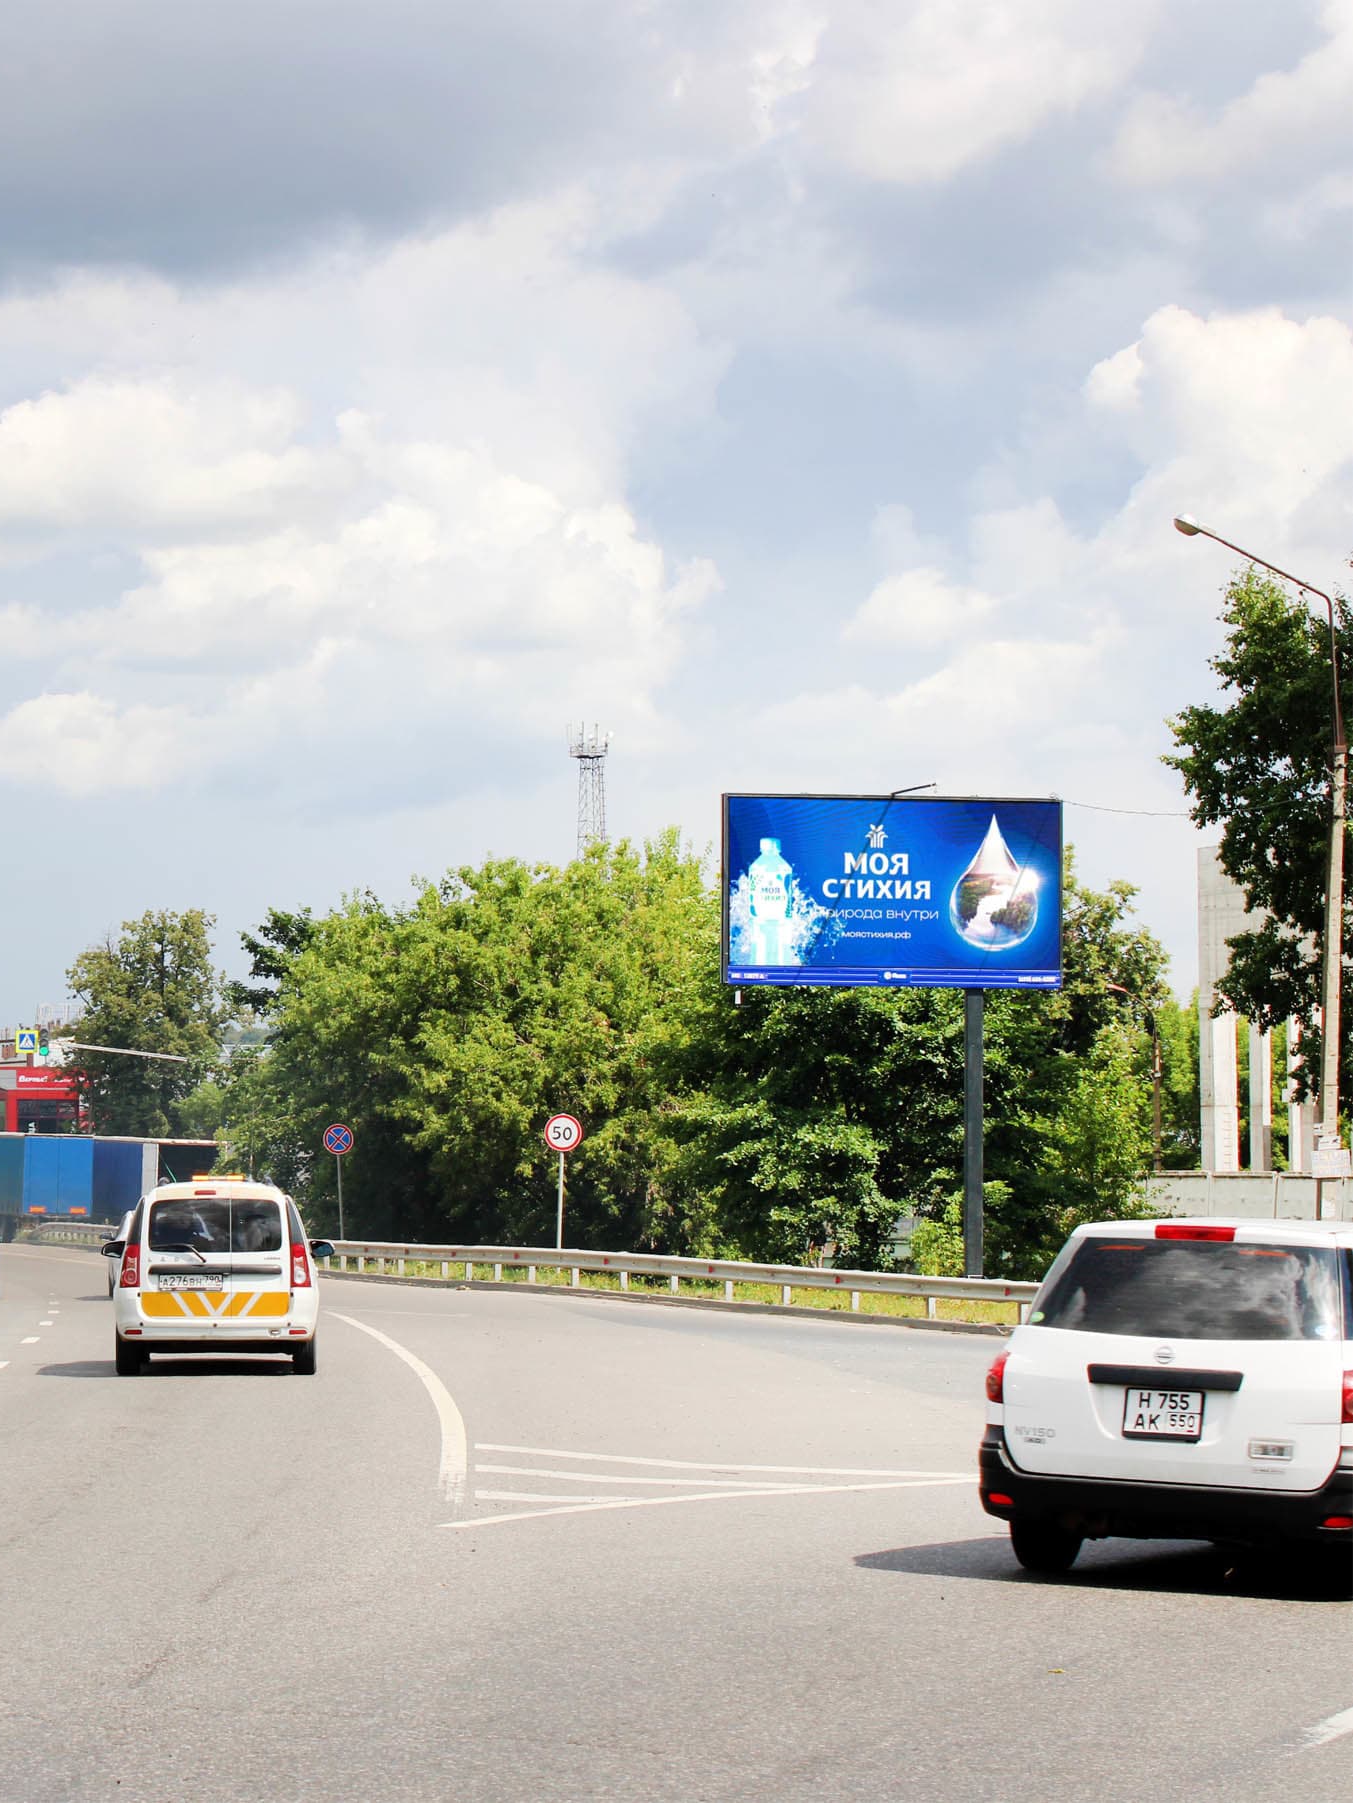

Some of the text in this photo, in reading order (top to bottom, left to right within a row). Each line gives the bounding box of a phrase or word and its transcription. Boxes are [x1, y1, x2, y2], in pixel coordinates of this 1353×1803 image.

[844, 852, 909, 875] МОЯ
[822, 878, 931, 900] СТИХИЯ
[886, 909, 939, 921] внутри
[552, 1126, 572, 1141] 50
[163, 1276, 202, 1287] А276ВН
[1139, 1392, 1190, 1410] Н 755
[1134, 1413, 1195, 1430] АК 550
